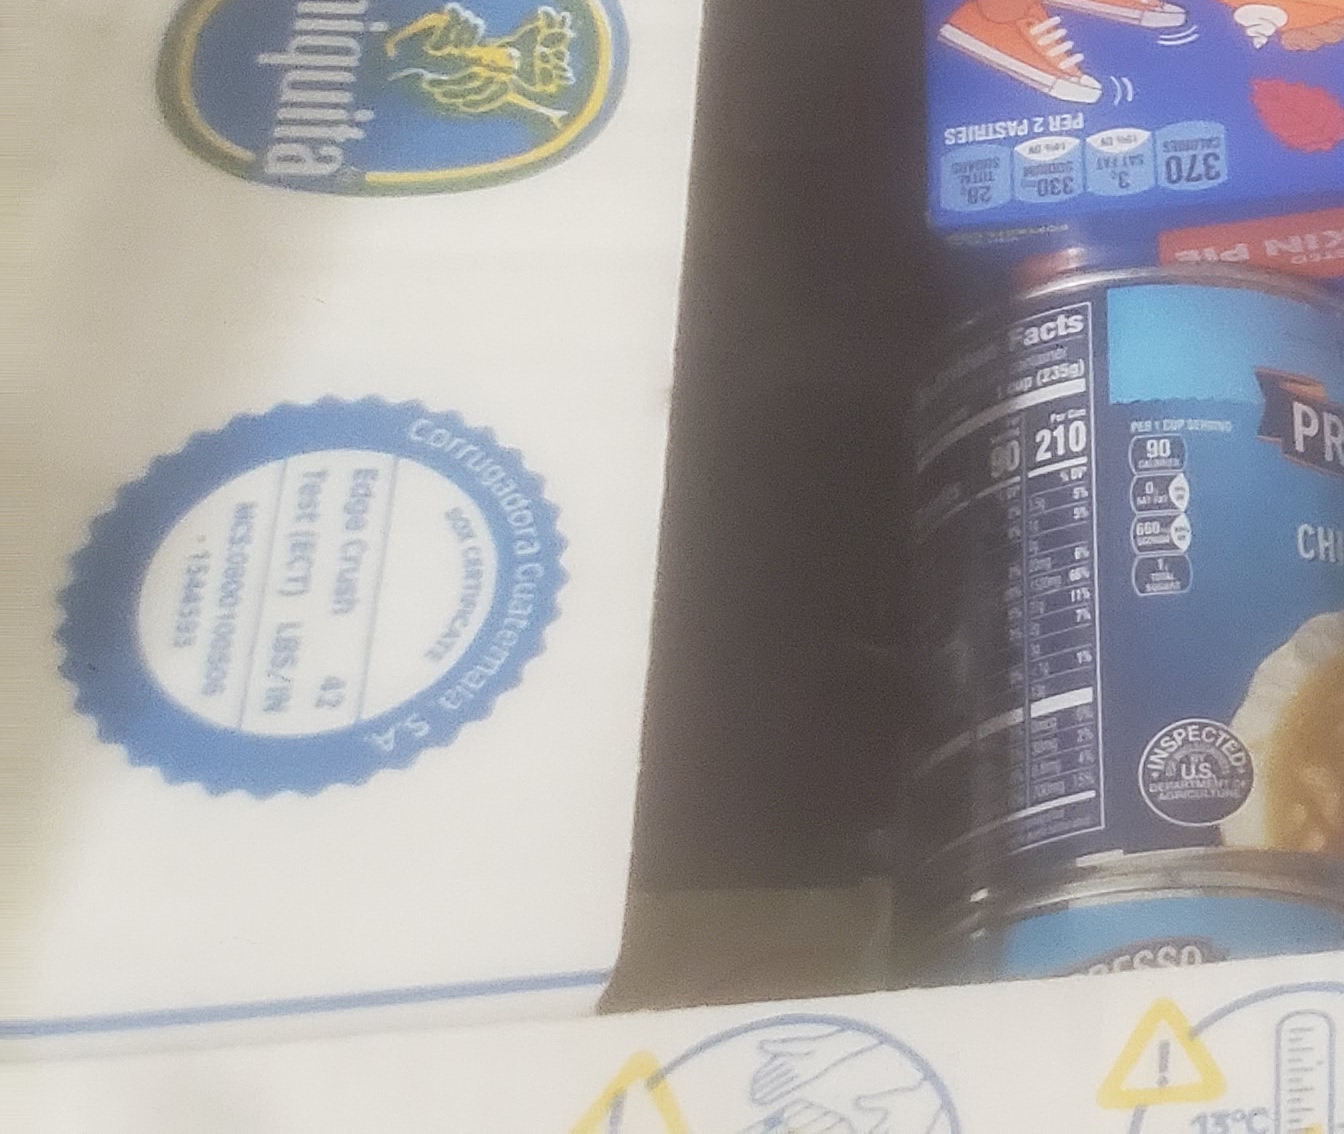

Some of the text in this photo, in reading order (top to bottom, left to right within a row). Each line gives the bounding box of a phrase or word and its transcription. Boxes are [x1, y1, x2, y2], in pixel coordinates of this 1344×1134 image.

[943, 113, 1085, 145] PER 2 PASTRIES
[1164, 152, 1221, 185] 370
[1034, 420, 1088, 463] 210
[1145, 439, 1171, 458] 90
[408, 418, 541, 557] Corrugadora
[438, 562, 545, 711] Guatemala
[1147, 724, 1248, 774] INSPECTED
